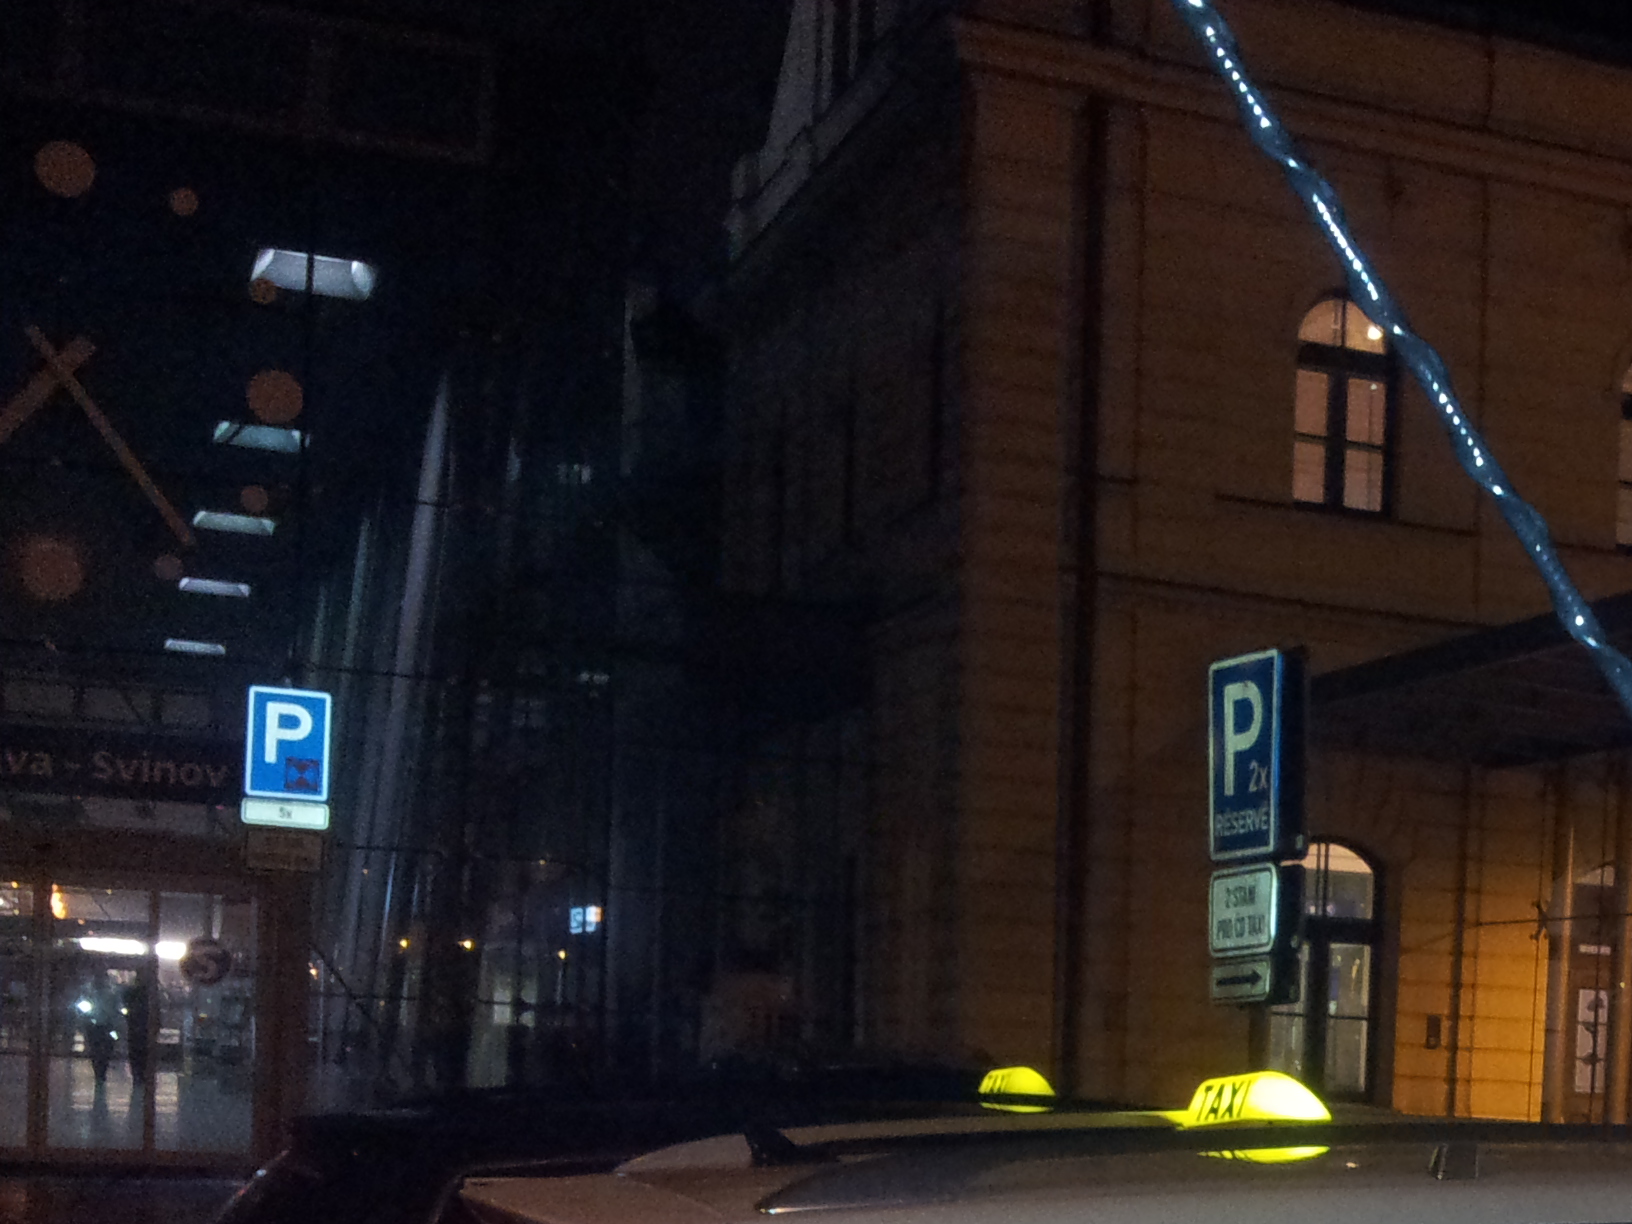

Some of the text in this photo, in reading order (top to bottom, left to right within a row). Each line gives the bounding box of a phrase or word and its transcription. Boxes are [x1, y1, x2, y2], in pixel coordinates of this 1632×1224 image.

[264, 701, 313, 764] P
[1224, 680, 1263, 796] P
[0, 750, 53, 778] va
[93, 750, 228, 788] Svinov
[1249, 759, 1268, 791] 2x
[1196, 1080, 1251, 1121] TAXI
